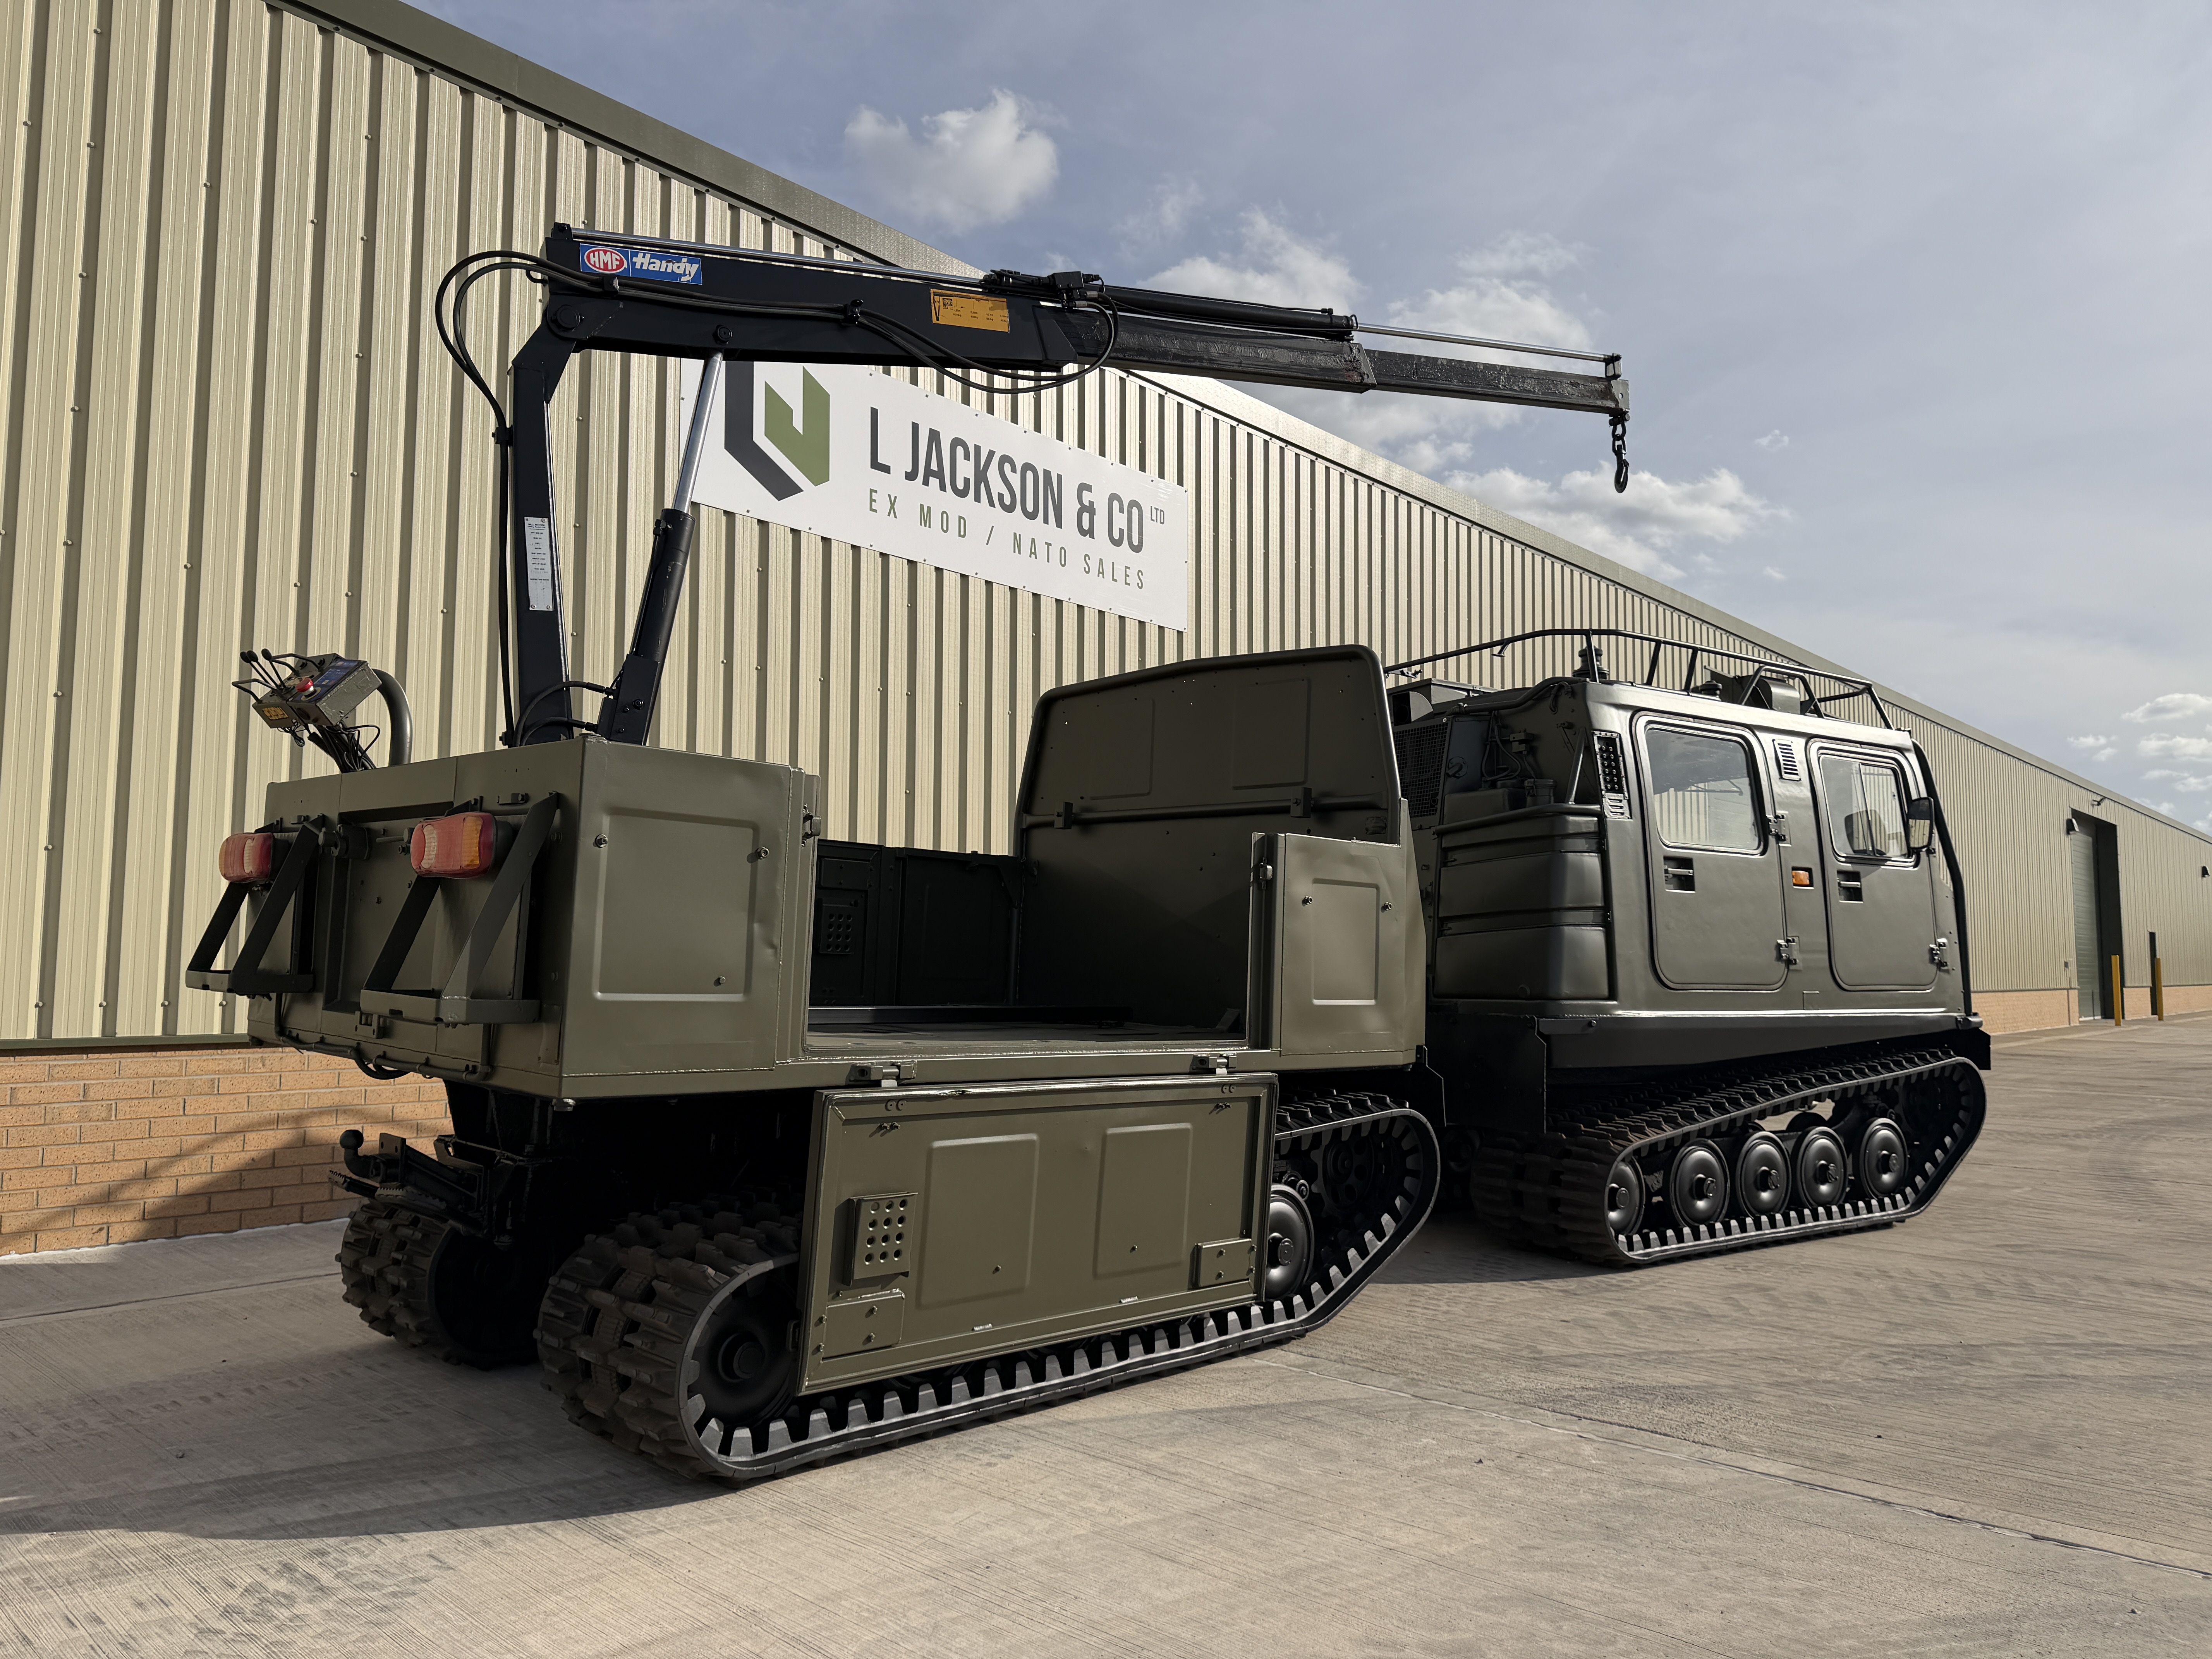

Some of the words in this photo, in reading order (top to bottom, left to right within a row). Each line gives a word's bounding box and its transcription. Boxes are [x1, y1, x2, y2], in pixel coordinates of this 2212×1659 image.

[589, 251, 620, 270] HMF
[632, 252, 699, 282] Handy
[870, 406, 891, 475] L
[905, 421, 1063, 529] JACKSON
[1077, 482, 1096, 540] &
[1108, 493, 1144, 553] CO
[1150, 505, 1165, 525] LTD
[869, 488, 898, 519] EX
[919, 503, 966, 538] MOD
[1013, 532, 1066, 567] NATO
[1084, 553, 1144, 590] SALES
